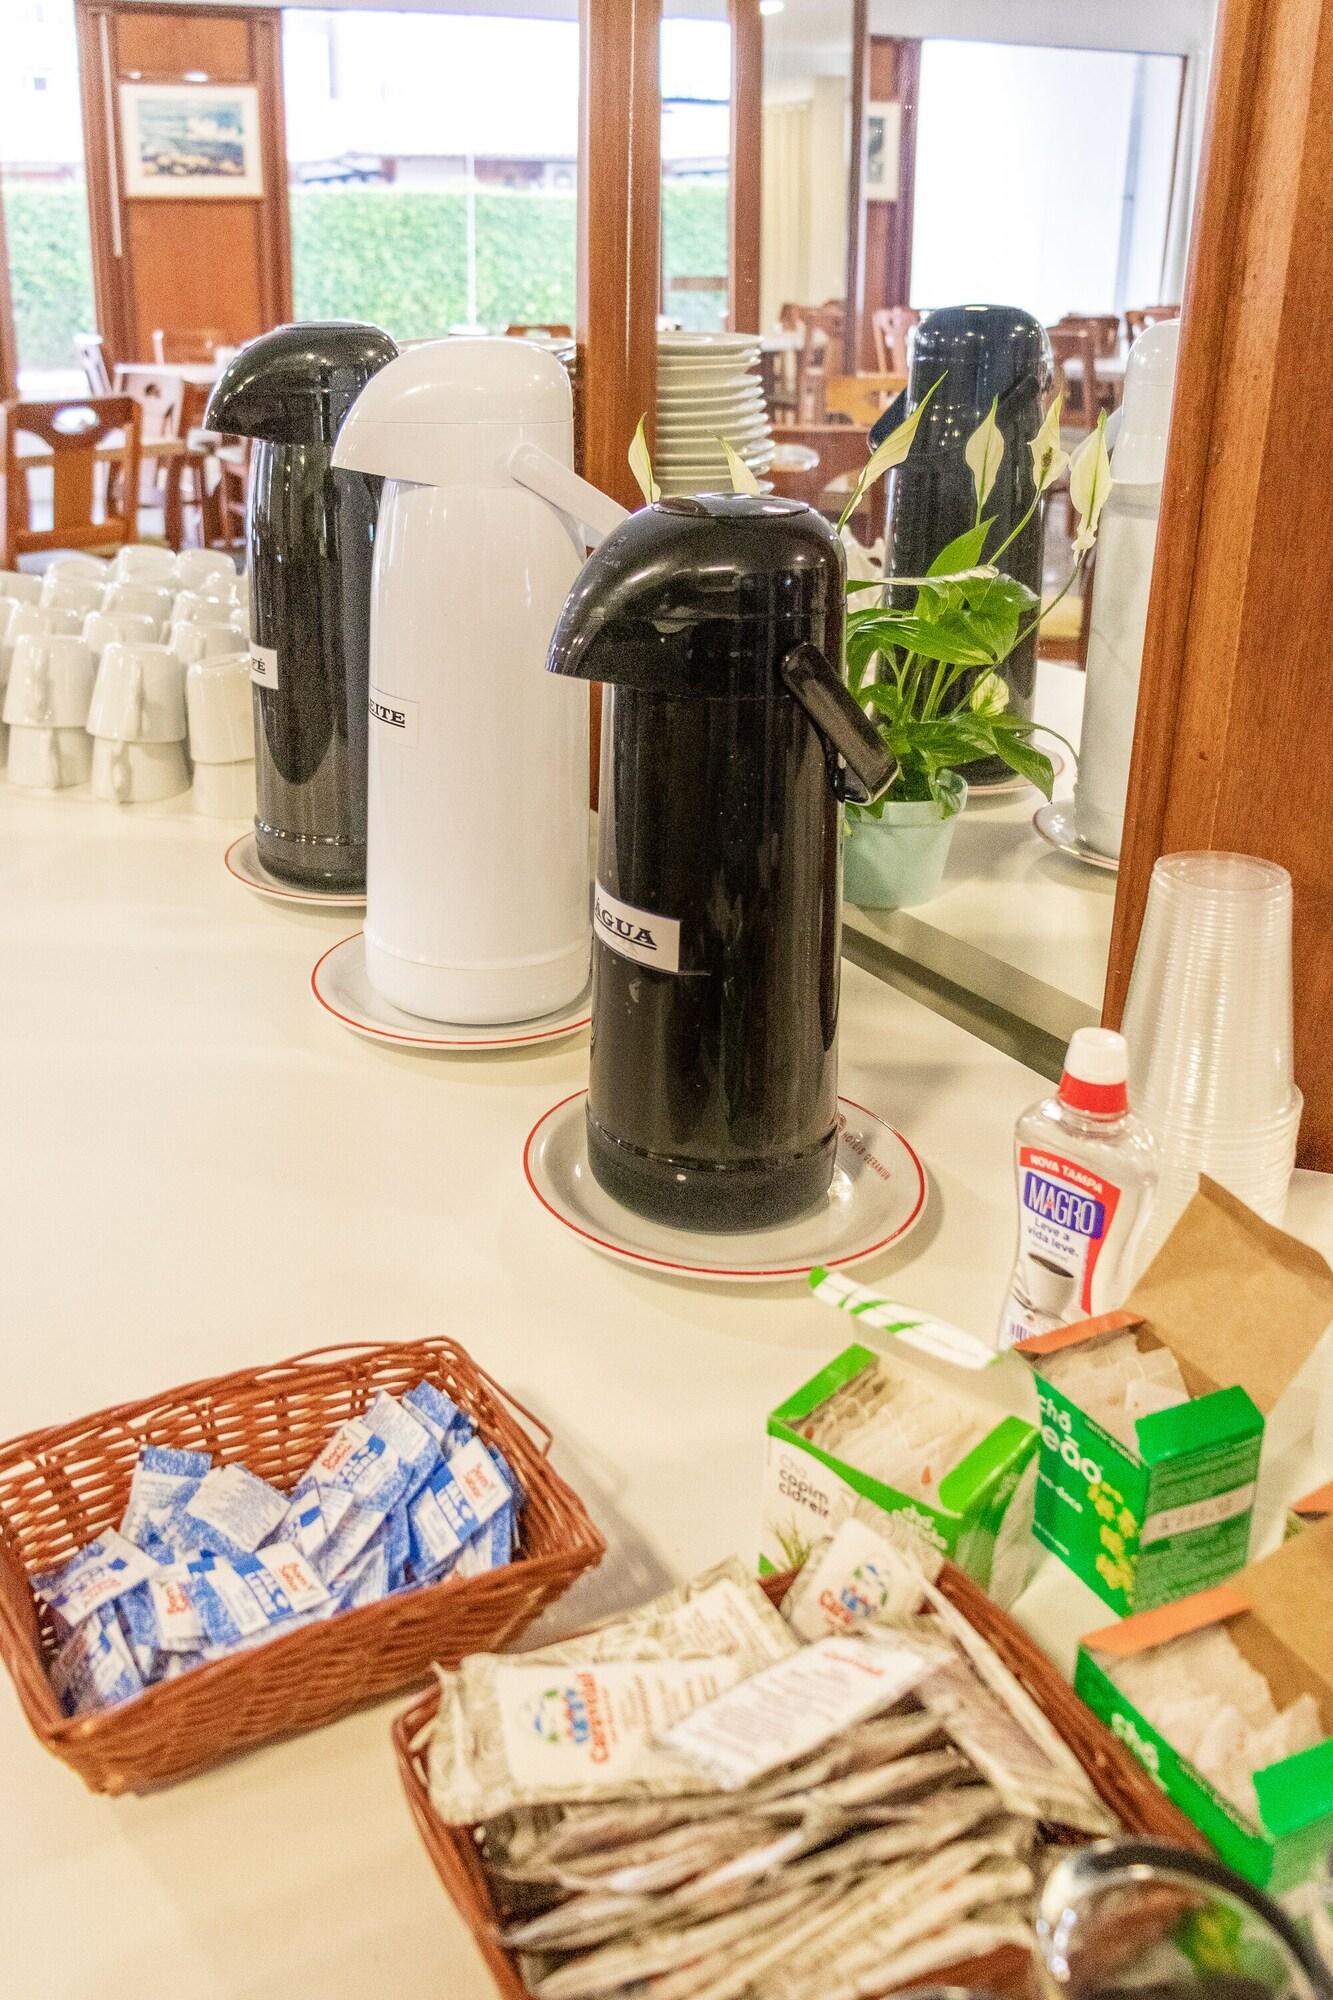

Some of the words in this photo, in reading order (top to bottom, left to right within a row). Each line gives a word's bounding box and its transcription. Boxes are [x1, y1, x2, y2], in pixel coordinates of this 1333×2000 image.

[1029, 1154, 1059, 1173] NOVA
[1061, 1165, 1103, 1194] TAMPA
[1028, 1176, 1095, 1235] MAGRO
[1027, 1226, 1049, 1243] vida
[1034, 1218, 1060, 1237] Leve
[1041, 1425, 1103, 1484] eão
[778, 1482, 830, 1517] cidreir
